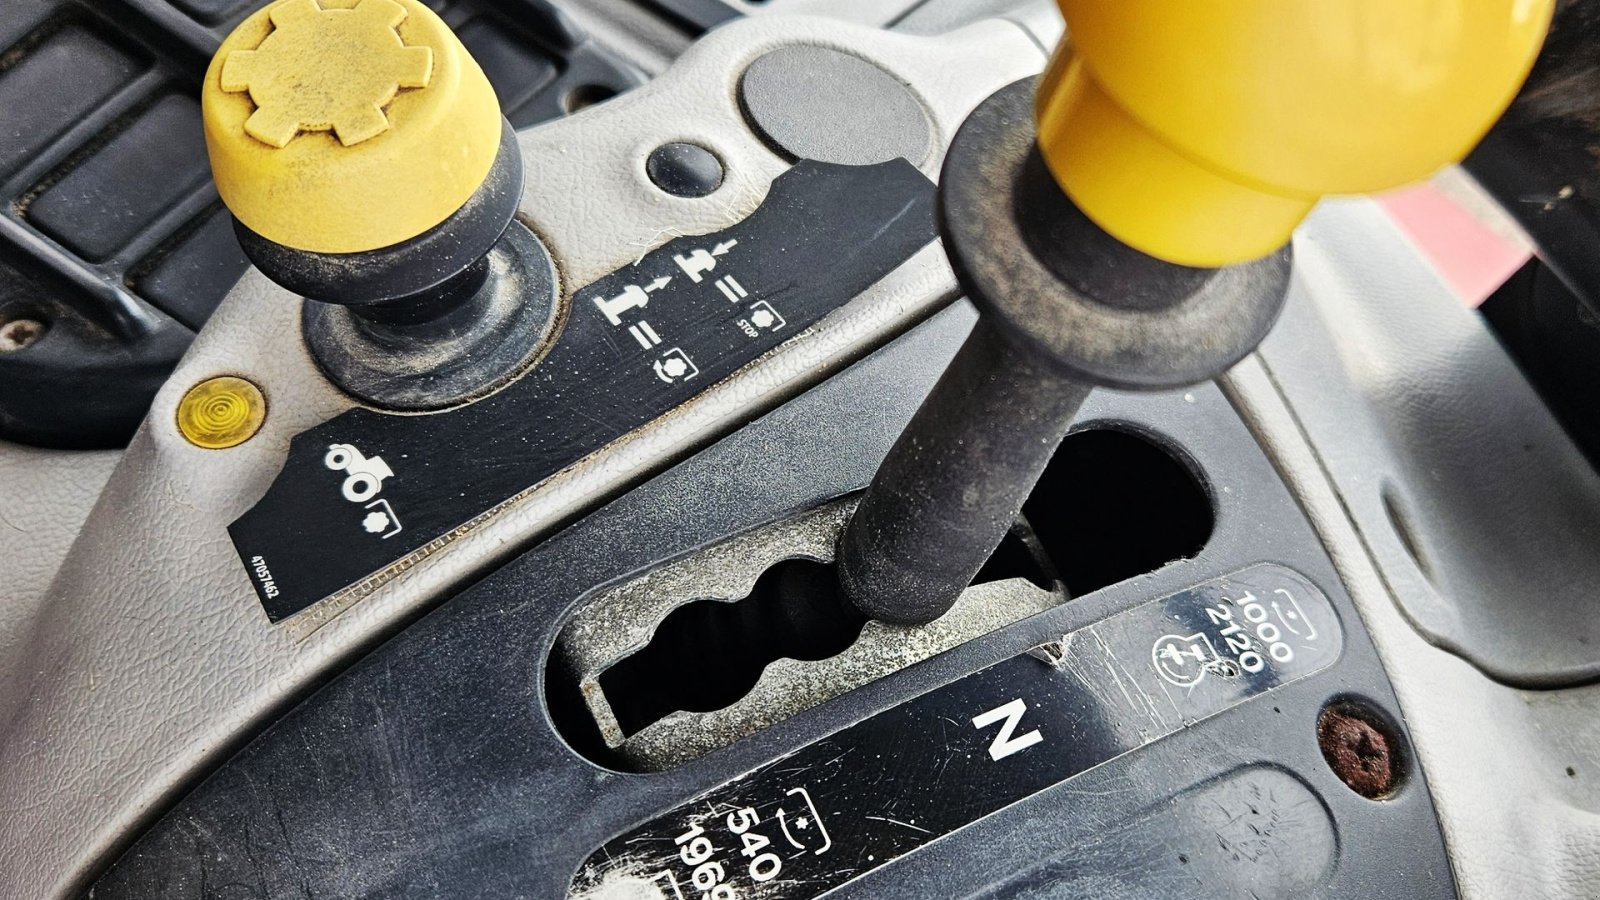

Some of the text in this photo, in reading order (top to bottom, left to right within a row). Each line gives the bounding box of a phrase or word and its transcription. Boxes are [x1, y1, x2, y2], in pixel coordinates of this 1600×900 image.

[737, 319, 759, 337] STOP
[251, 555, 279, 599] 47057462
[1205, 604, 1265, 673] 2120
[1237, 591, 1294, 663] 1000
[972, 698, 1043, 762] N
[727, 807, 782, 882] 540
